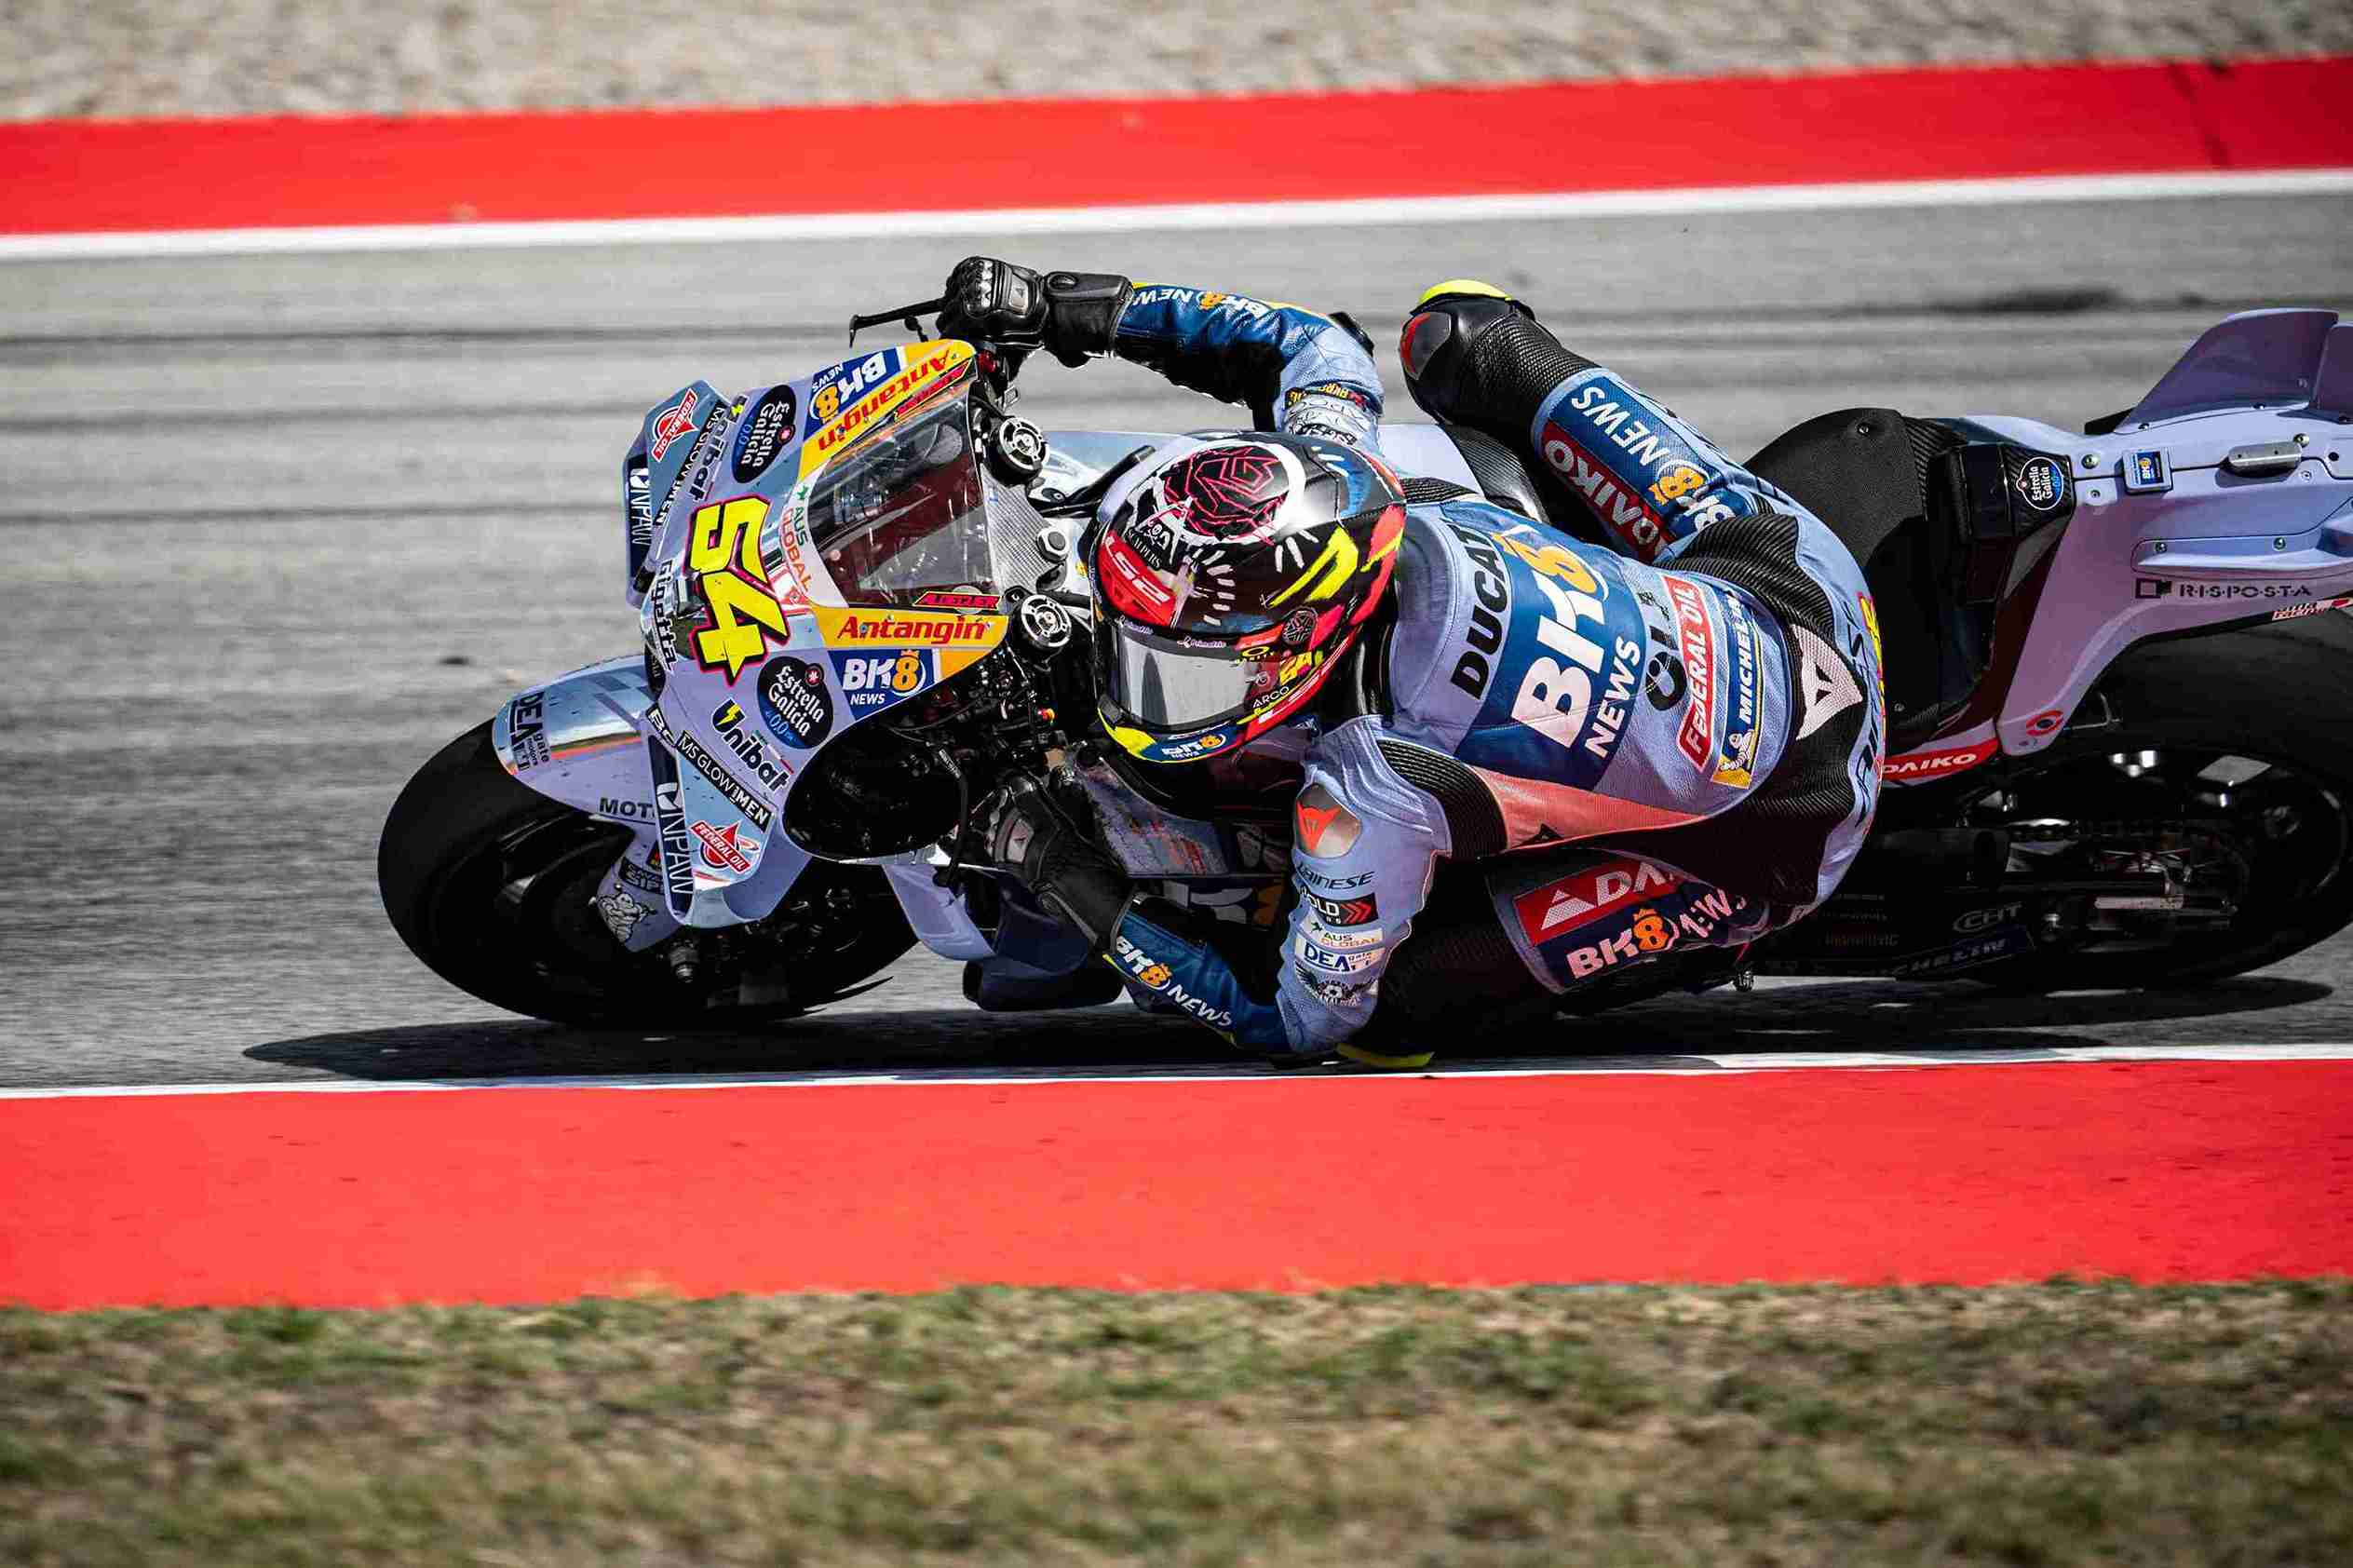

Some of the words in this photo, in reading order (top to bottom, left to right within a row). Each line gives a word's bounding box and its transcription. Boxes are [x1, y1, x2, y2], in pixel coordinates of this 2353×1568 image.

[1132, 287, 1193, 307] NEW
[810, 351, 886, 425] BK8
[812, 362, 845, 393] NEWS
[818, 349, 951, 451] Antangin
[740, 403, 776, 466] Galicia
[752, 400, 791, 467] Estrella
[1570, 385, 1672, 467] NEWS
[2029, 466, 2044, 501] Estrella
[2039, 466, 2054, 500] Galicia
[794, 507, 809, 547] AUS
[1127, 528, 1163, 570] SCALPERS
[685, 493, 791, 683] 54
[1447, 523, 1508, 700] DUCAT
[837, 615, 990, 645] Antangin
[1490, 524, 1610, 749] BK8
[775, 665, 826, 724] Estrella
[842, 649, 926, 697] BK8
[1252, 685, 1291, 709] ARCO
[1585, 636, 1642, 760] NEWS
[1686, 631, 1708, 755] FEDERAL
[768, 682, 812, 737] Galicia
[849, 693, 886, 706] NEWS
[534, 732, 551, 764] gate
[677, 737, 699, 760] MS
[696, 754, 737, 792] GLOW
[711, 697, 792, 793] Unibat
[1881, 753, 1977, 775] DAIKO
[599, 796, 656, 819] MOT
[696, 823, 735, 860] FEDERAL
[730, 853, 748, 872] OIL
[1305, 941, 1350, 972] DEA
[1324, 932, 1354, 942] AUS
[1566, 908, 1680, 979] BK8
[1116, 935, 1172, 991] BK8
[1167, 983, 1233, 1025] NEWS
